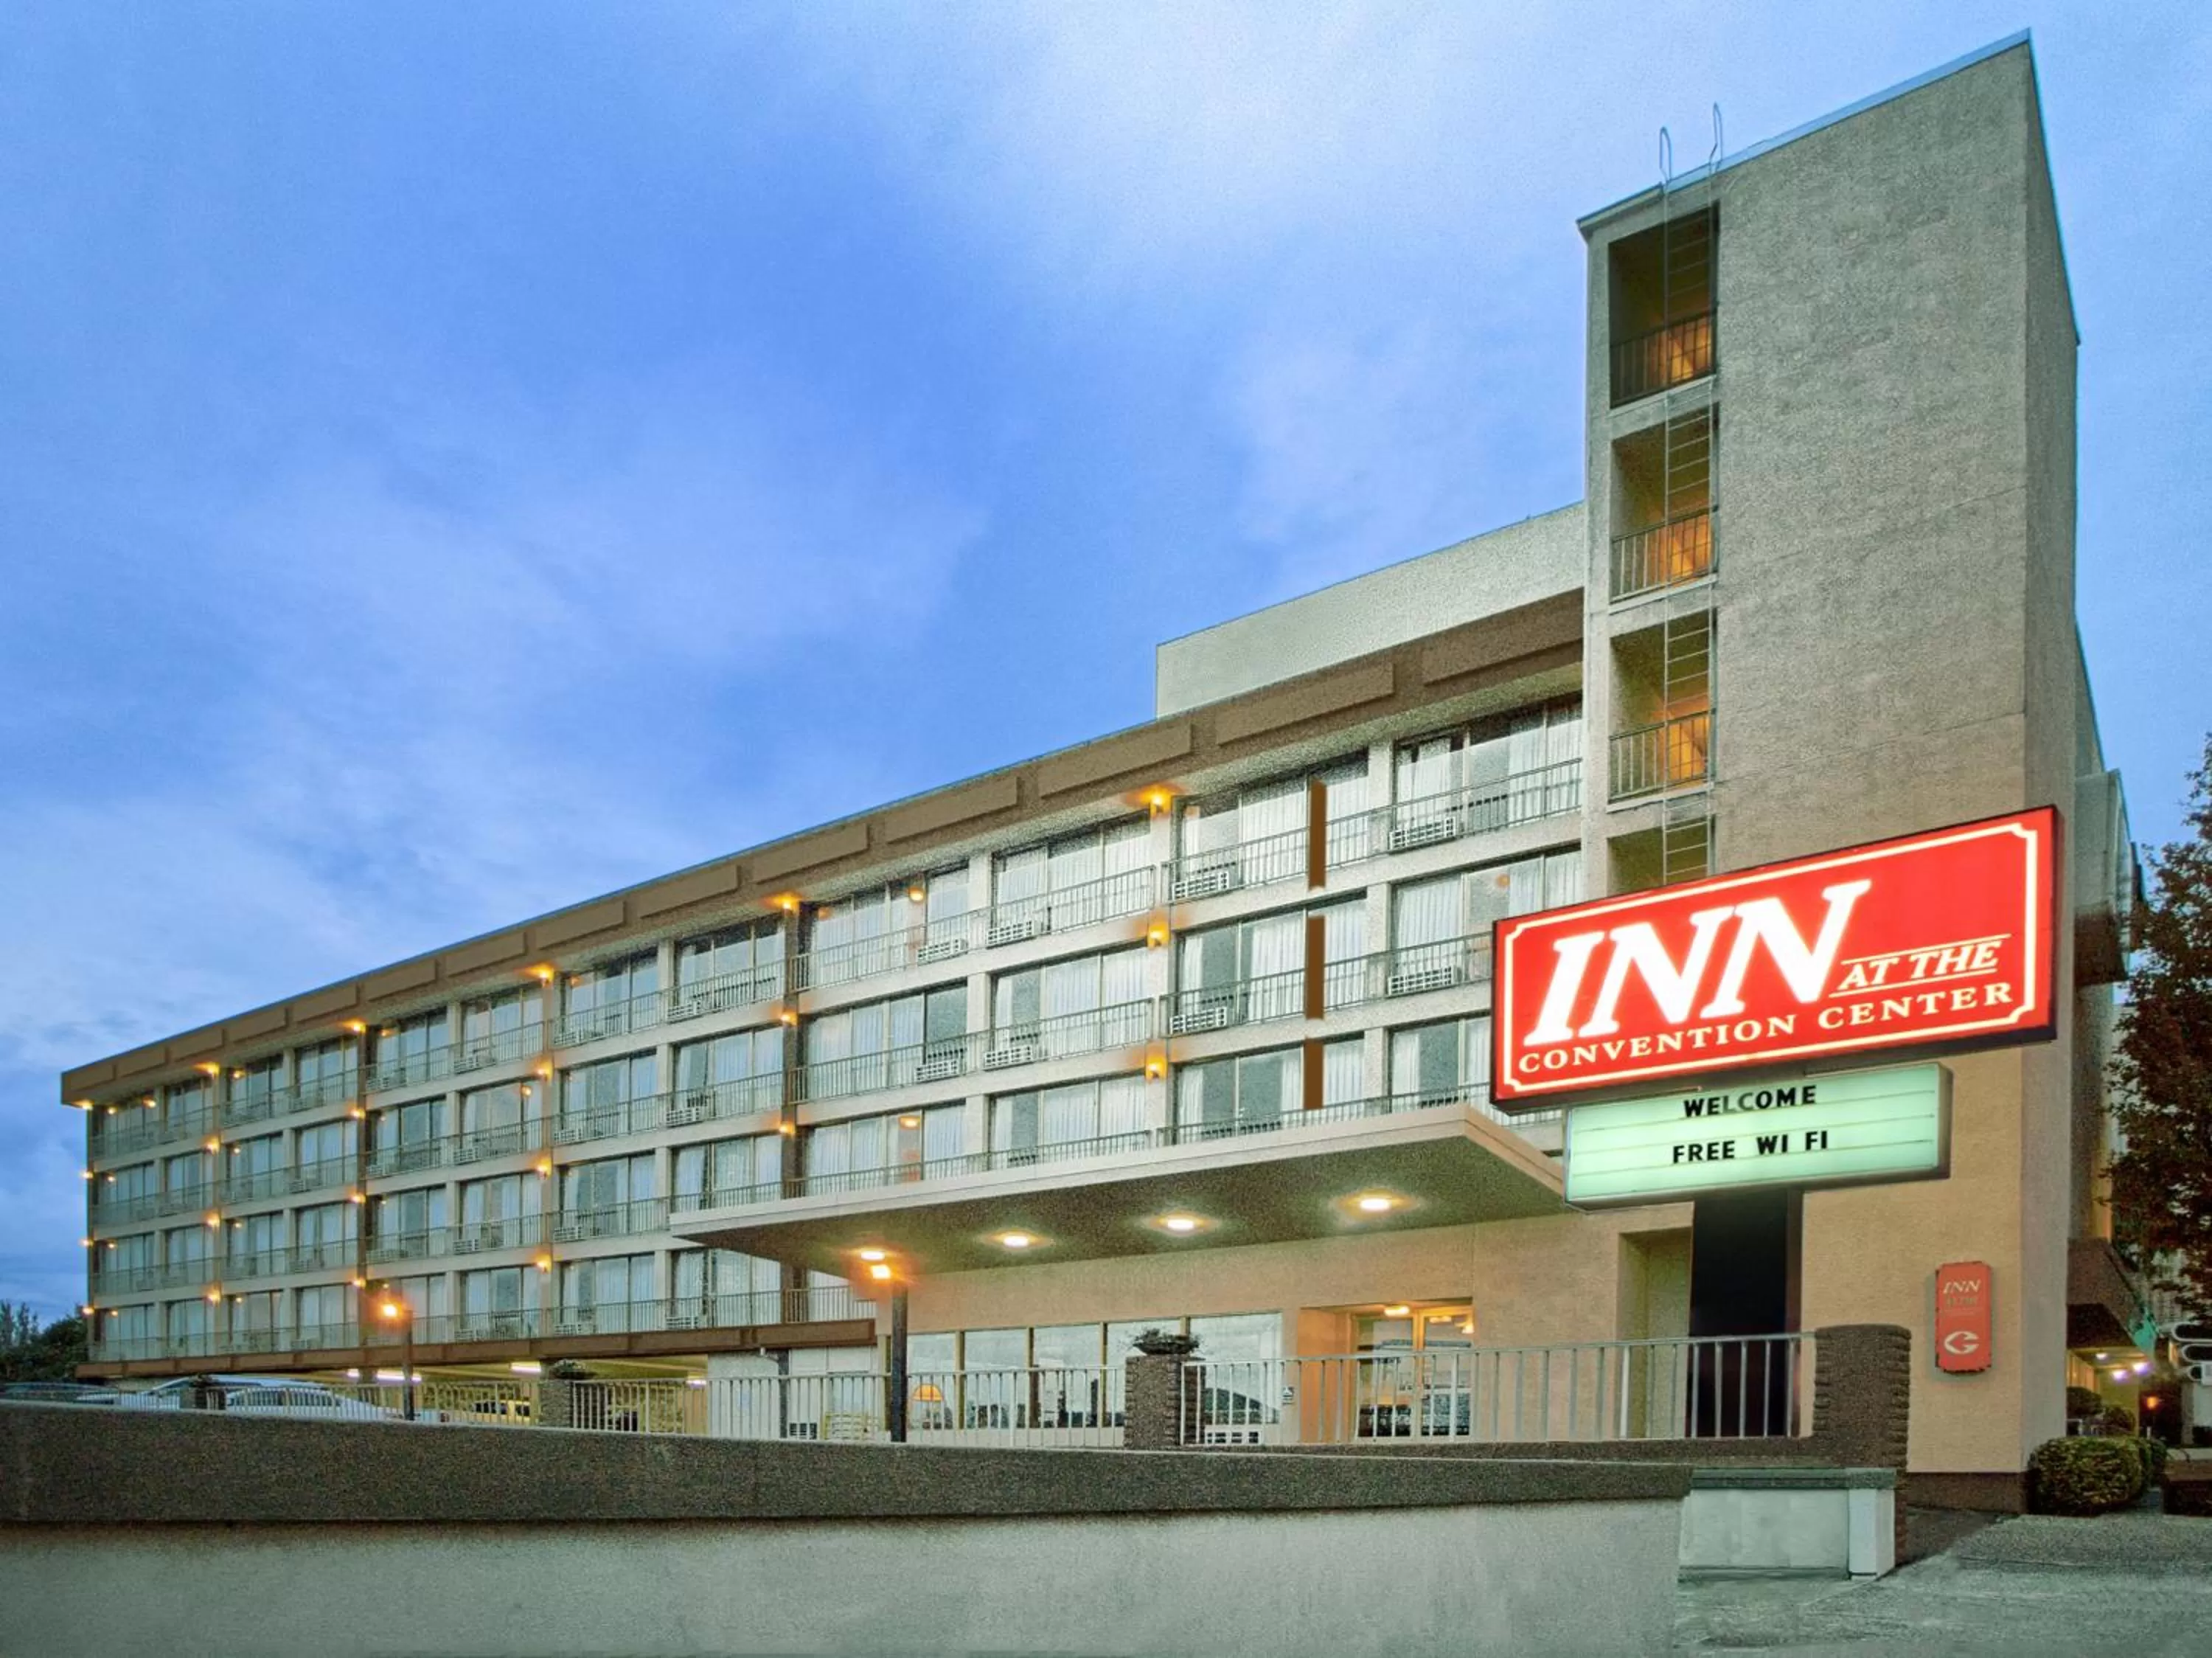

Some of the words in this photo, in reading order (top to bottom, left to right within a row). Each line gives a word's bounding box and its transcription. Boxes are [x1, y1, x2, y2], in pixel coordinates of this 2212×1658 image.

[1523, 879, 1871, 1046] INN
[1837, 958, 1900, 990] AT
[1909, 940, 2001, 979] THE
[1518, 1013, 1795, 1072] CONVENTION
[1818, 982, 2012, 1029] CENTER
[1684, 1085, 1816, 1117] WELCOME
[1673, 1141, 1734, 1164] FREE
[1757, 1134, 1788, 1155] WI
[1806, 1131, 1828, 1151] FI
[1943, 1280, 1980, 1294] INN
